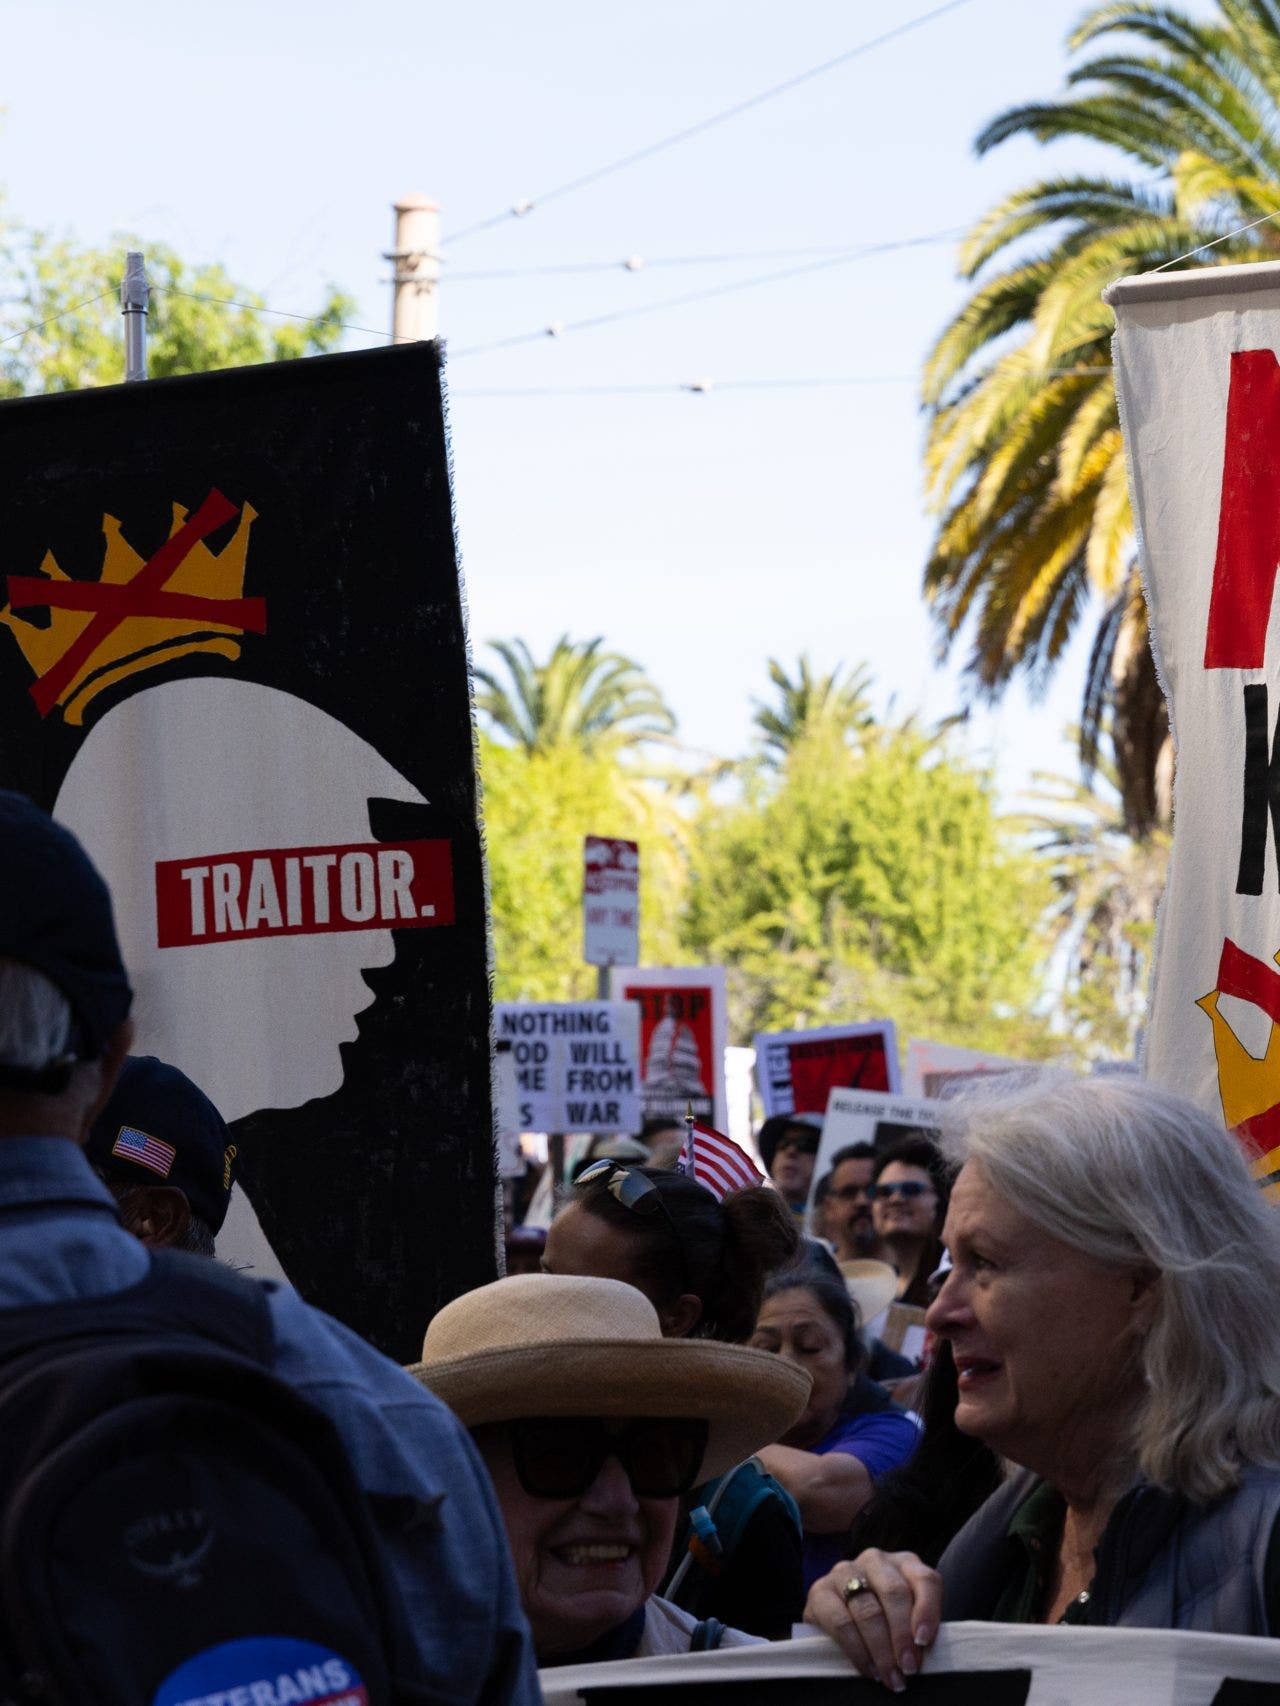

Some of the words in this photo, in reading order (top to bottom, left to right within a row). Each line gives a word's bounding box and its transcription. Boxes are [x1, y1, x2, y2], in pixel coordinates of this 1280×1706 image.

[181, 850, 435, 935] TRAITOR.
[503, 1011, 610, 1035] NOTHING
[570, 1041, 627, 1065] WILL
[566, 1069, 634, 1092] FROM
[566, 1102, 621, 1125] WAR
